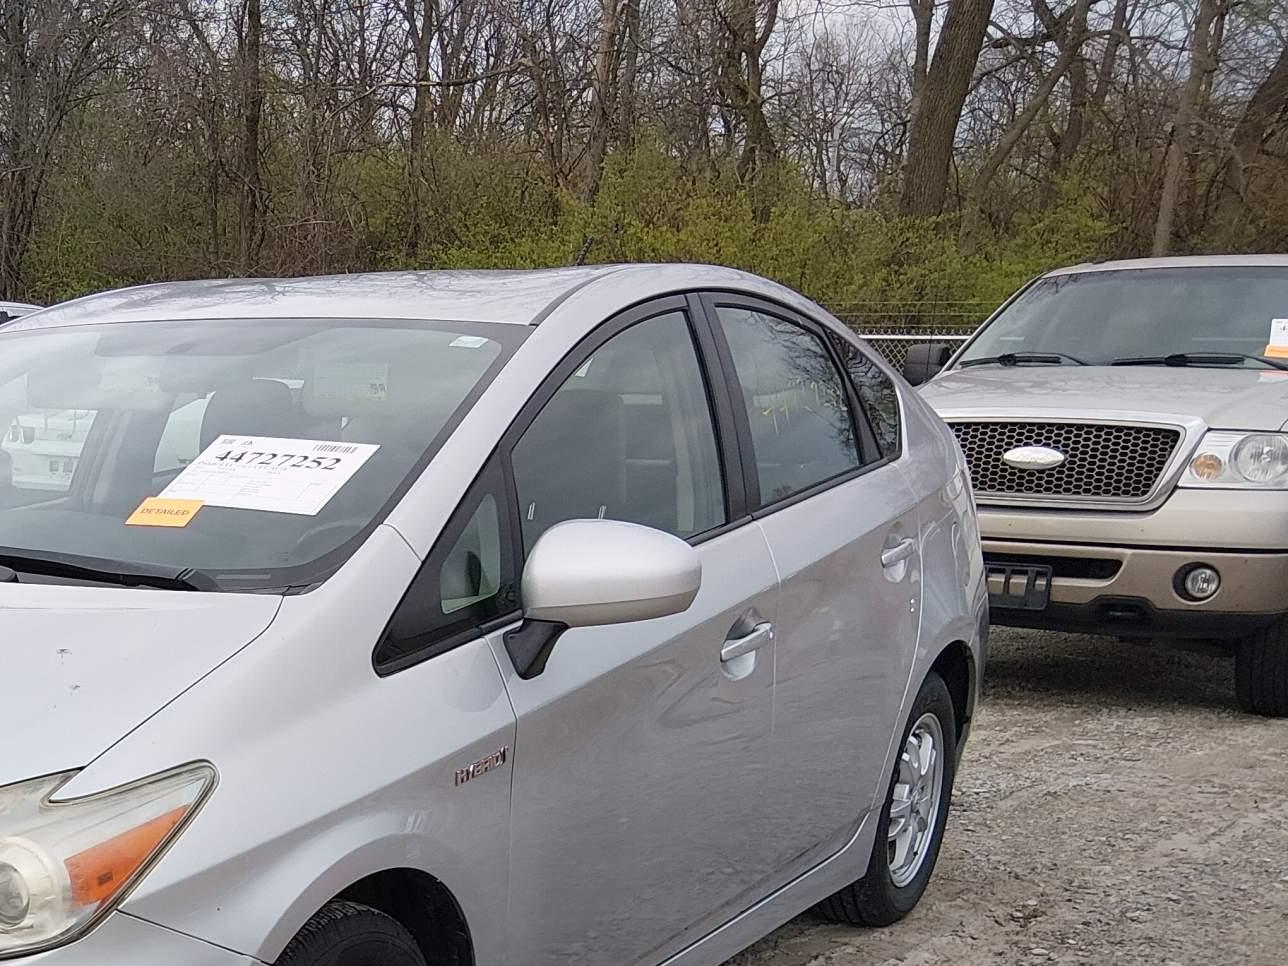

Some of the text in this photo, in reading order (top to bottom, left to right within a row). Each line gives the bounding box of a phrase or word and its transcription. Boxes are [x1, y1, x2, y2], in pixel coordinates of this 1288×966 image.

[214, 449, 343, 472] 44727252
[139, 506, 191, 517] DETAILED
[455, 751, 502, 787] HYBRID
